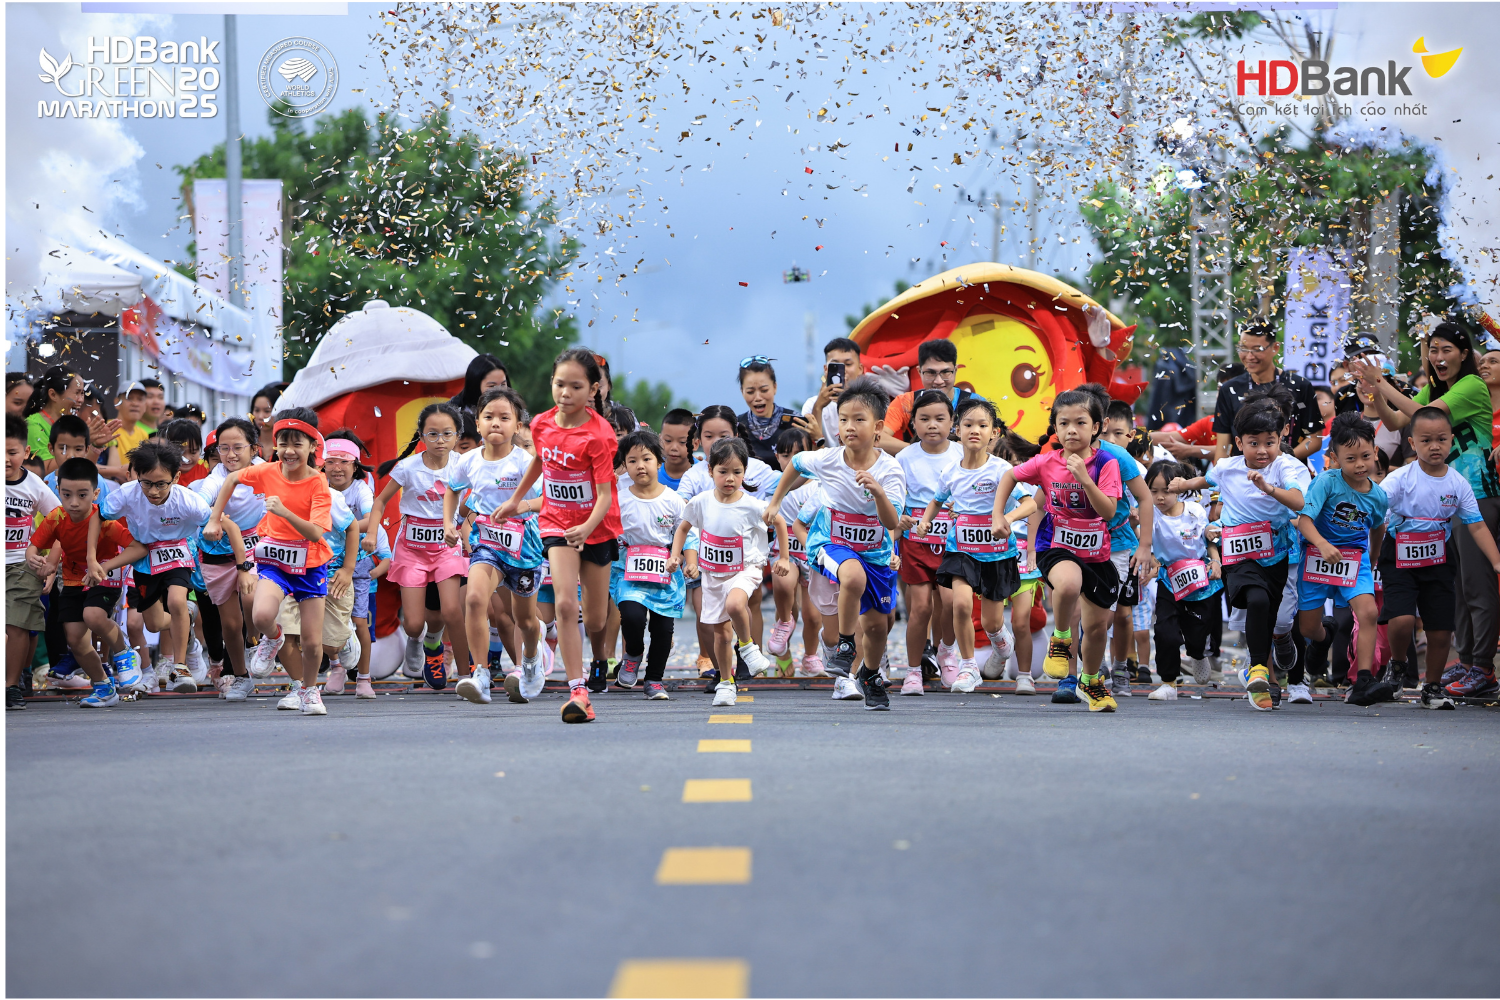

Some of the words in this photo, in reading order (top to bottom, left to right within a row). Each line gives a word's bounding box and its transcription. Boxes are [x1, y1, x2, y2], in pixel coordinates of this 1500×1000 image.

[1303, 303, 1332, 387] Bank
[541, 445, 576, 467] ptr
[549, 483, 584, 499] 15001
[5, 529, 24, 541] 120
[411, 527, 445, 542] 15013
[838, 525, 876, 542] 15102
[961, 528, 1000, 543] 1500
[1060, 530, 1098, 548] 15020
[1229, 535, 1263, 554] 15115
[1405, 543, 1437, 559] 15113
[263, 545, 298, 564] 15011
[704, 546, 733, 563] 15119
[633, 558, 665, 574] 15015
[1315, 559, 1350, 576] 15101
[1174, 568, 1199, 589] 15018
